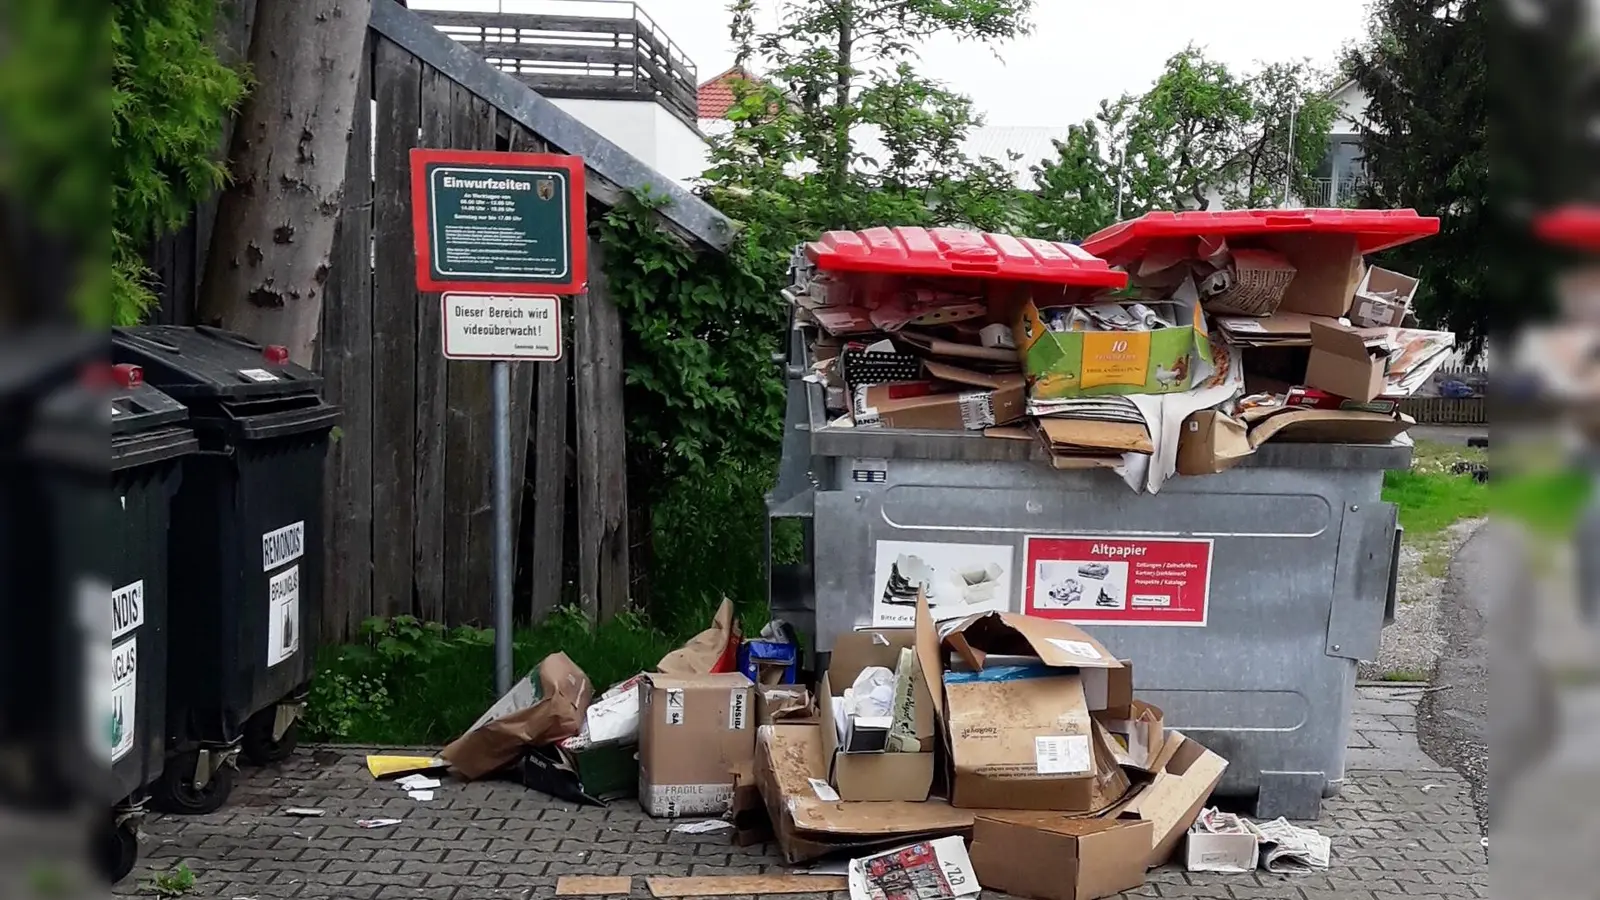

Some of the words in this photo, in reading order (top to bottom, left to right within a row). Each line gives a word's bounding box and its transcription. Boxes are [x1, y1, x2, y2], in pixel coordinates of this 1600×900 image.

[443, 176, 531, 191] Einwurfzeiten
[455, 305, 484, 317] Dieser
[489, 306, 523, 318] Bereich
[528, 308, 548, 319] wird
[463, 323, 541, 337] videoüberwacht!
[1112, 340, 1128, 353] 10
[264, 526, 300, 566] REMONDIS
[1091, 544, 1147, 558] Altpapier
[665, 786, 704, 794] FRAGILE
